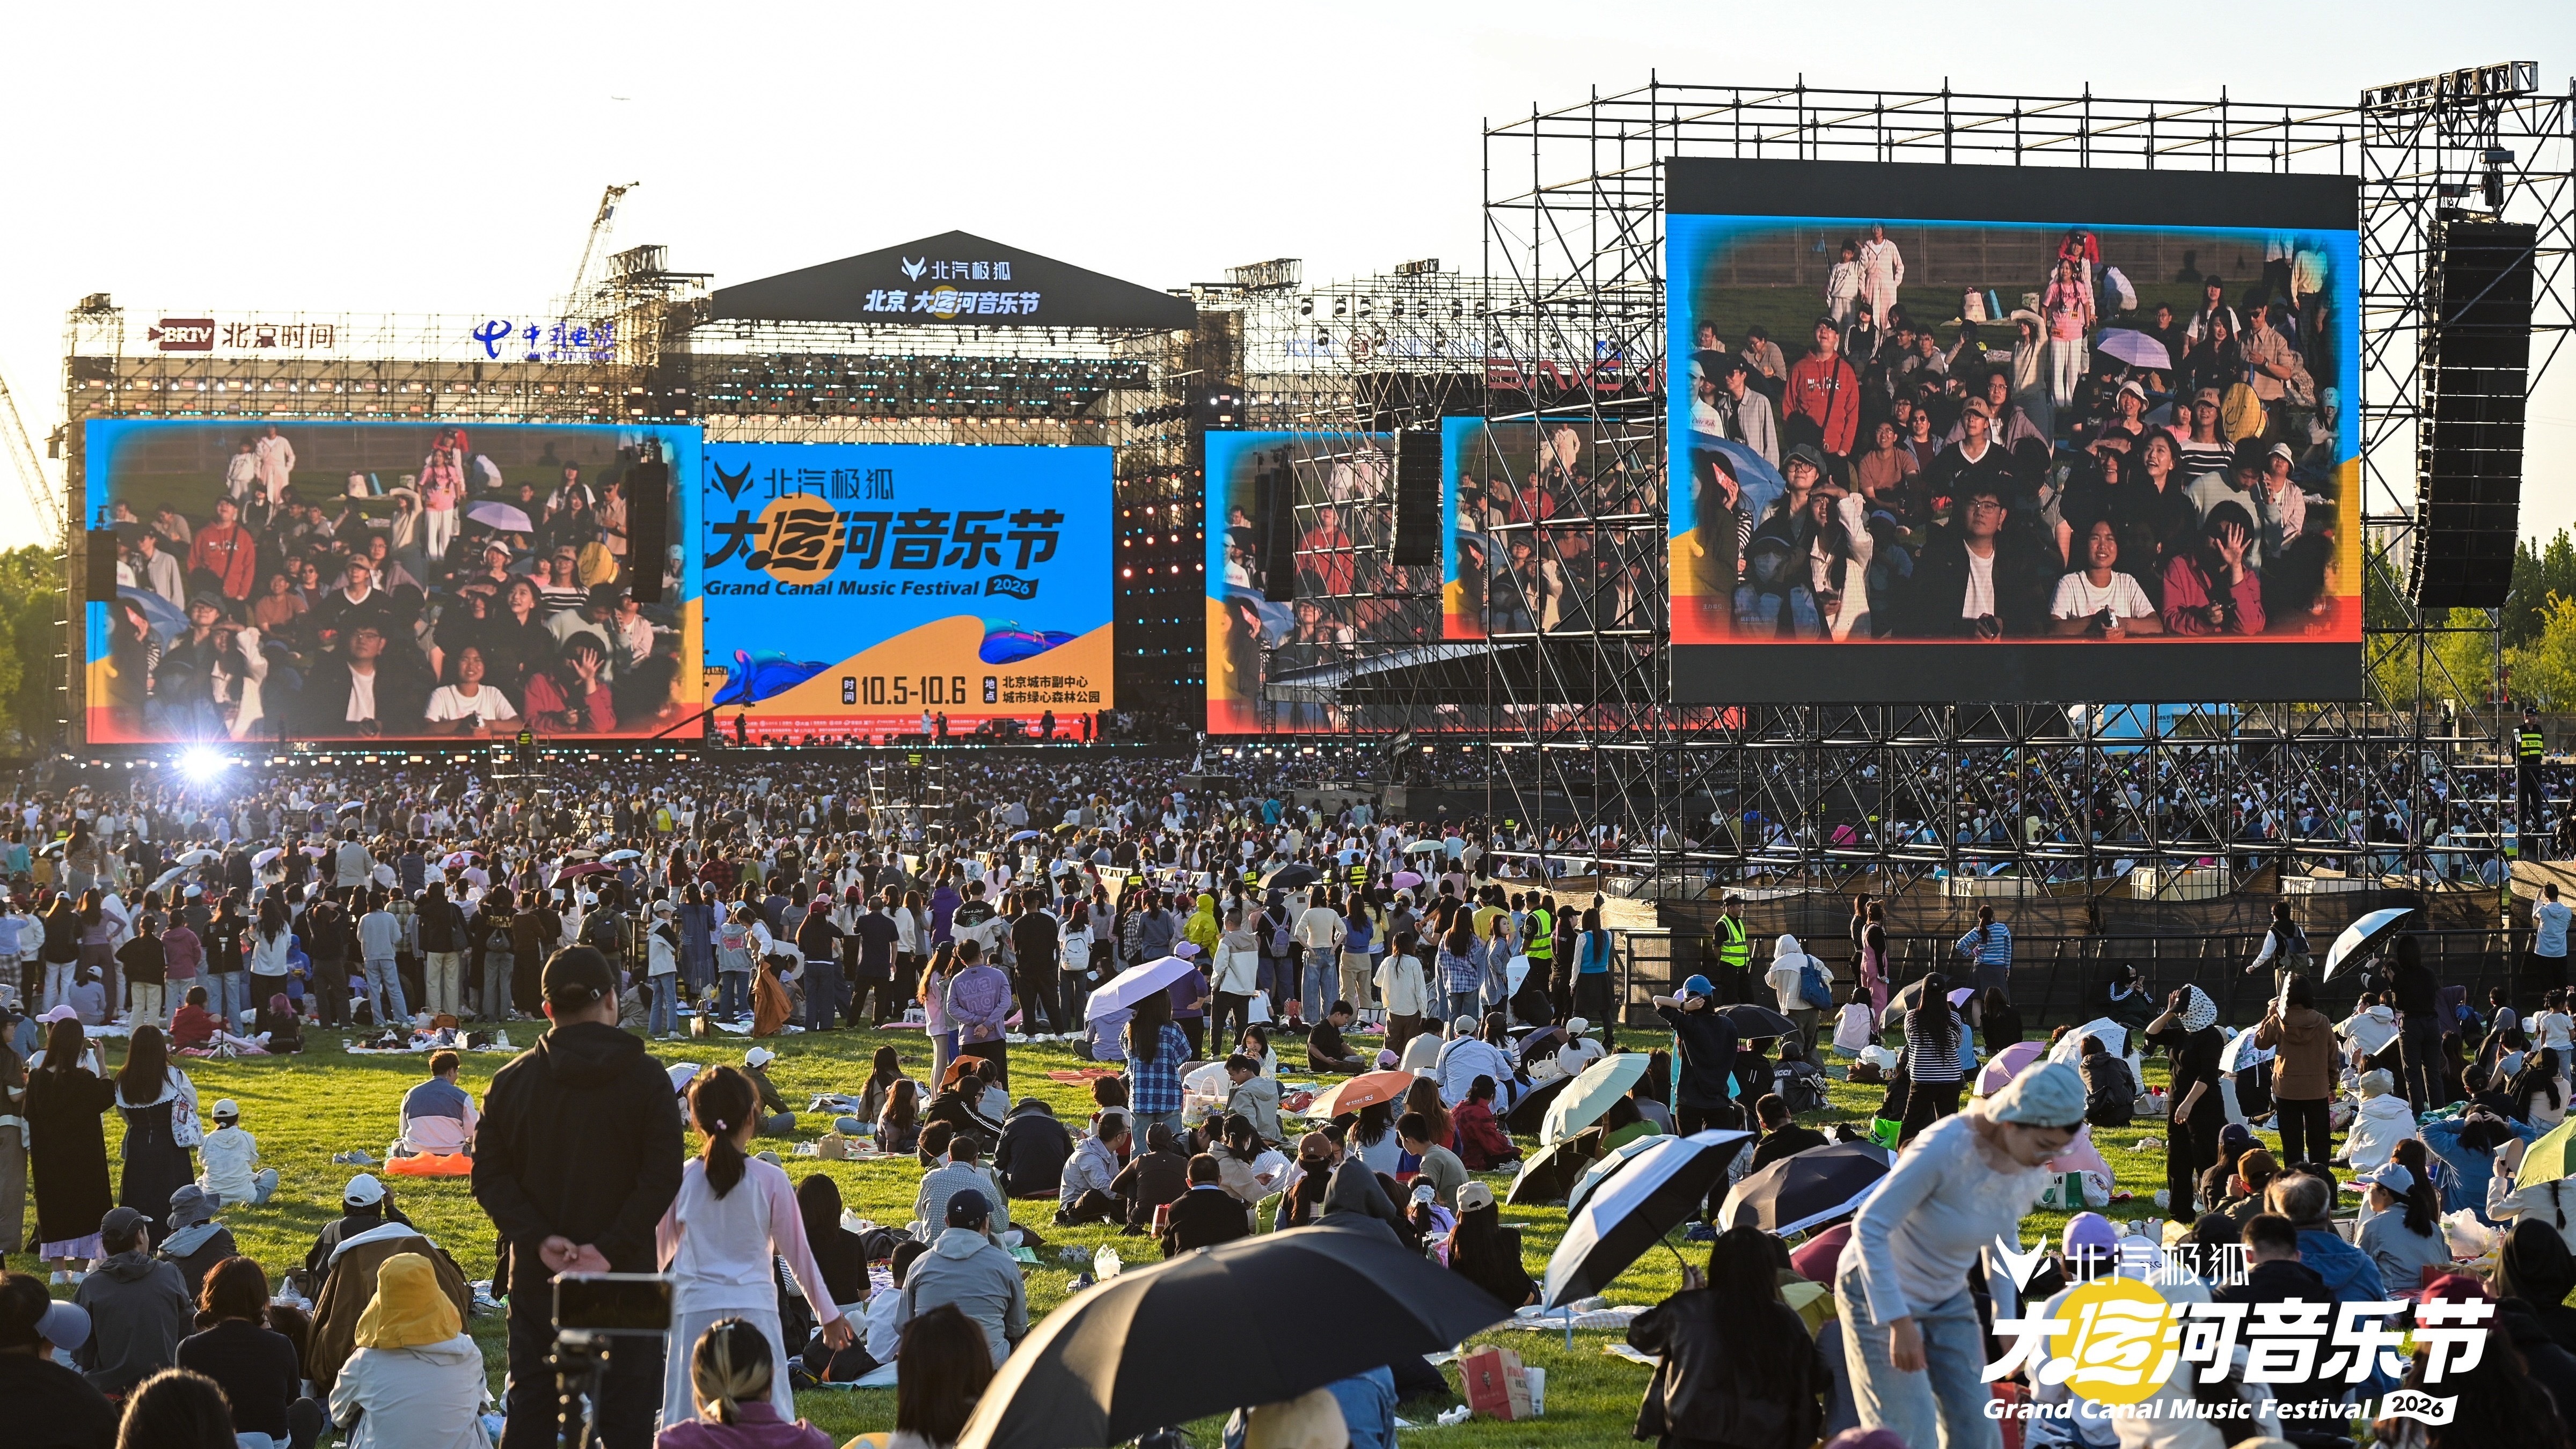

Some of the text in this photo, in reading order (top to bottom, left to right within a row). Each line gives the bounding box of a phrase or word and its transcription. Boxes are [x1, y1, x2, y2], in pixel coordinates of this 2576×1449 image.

[931, 260, 1011, 281] 北汽极狐
[863, 289, 1041, 315] 北京 大运河音乐节
[164, 326, 213, 343] BRTV
[222, 322, 334, 348] 北京时间
[764, 468, 895, 500] 北汽极狐
[704, 508, 1065, 571] 大运河音乐节
[706, 579, 1030, 595] Grand Canal Music Festival 2026
[844, 679, 854, 702] 时间
[862, 676, 966, 705] 10.5-10.6
[985, 679, 996, 701] 地点
[1002, 676, 1088, 689] 北京城市副中心
[1002, 691, 1100, 704] 城市绿心森林公园
[1792, 1220, 1813, 1230] RUNNING
